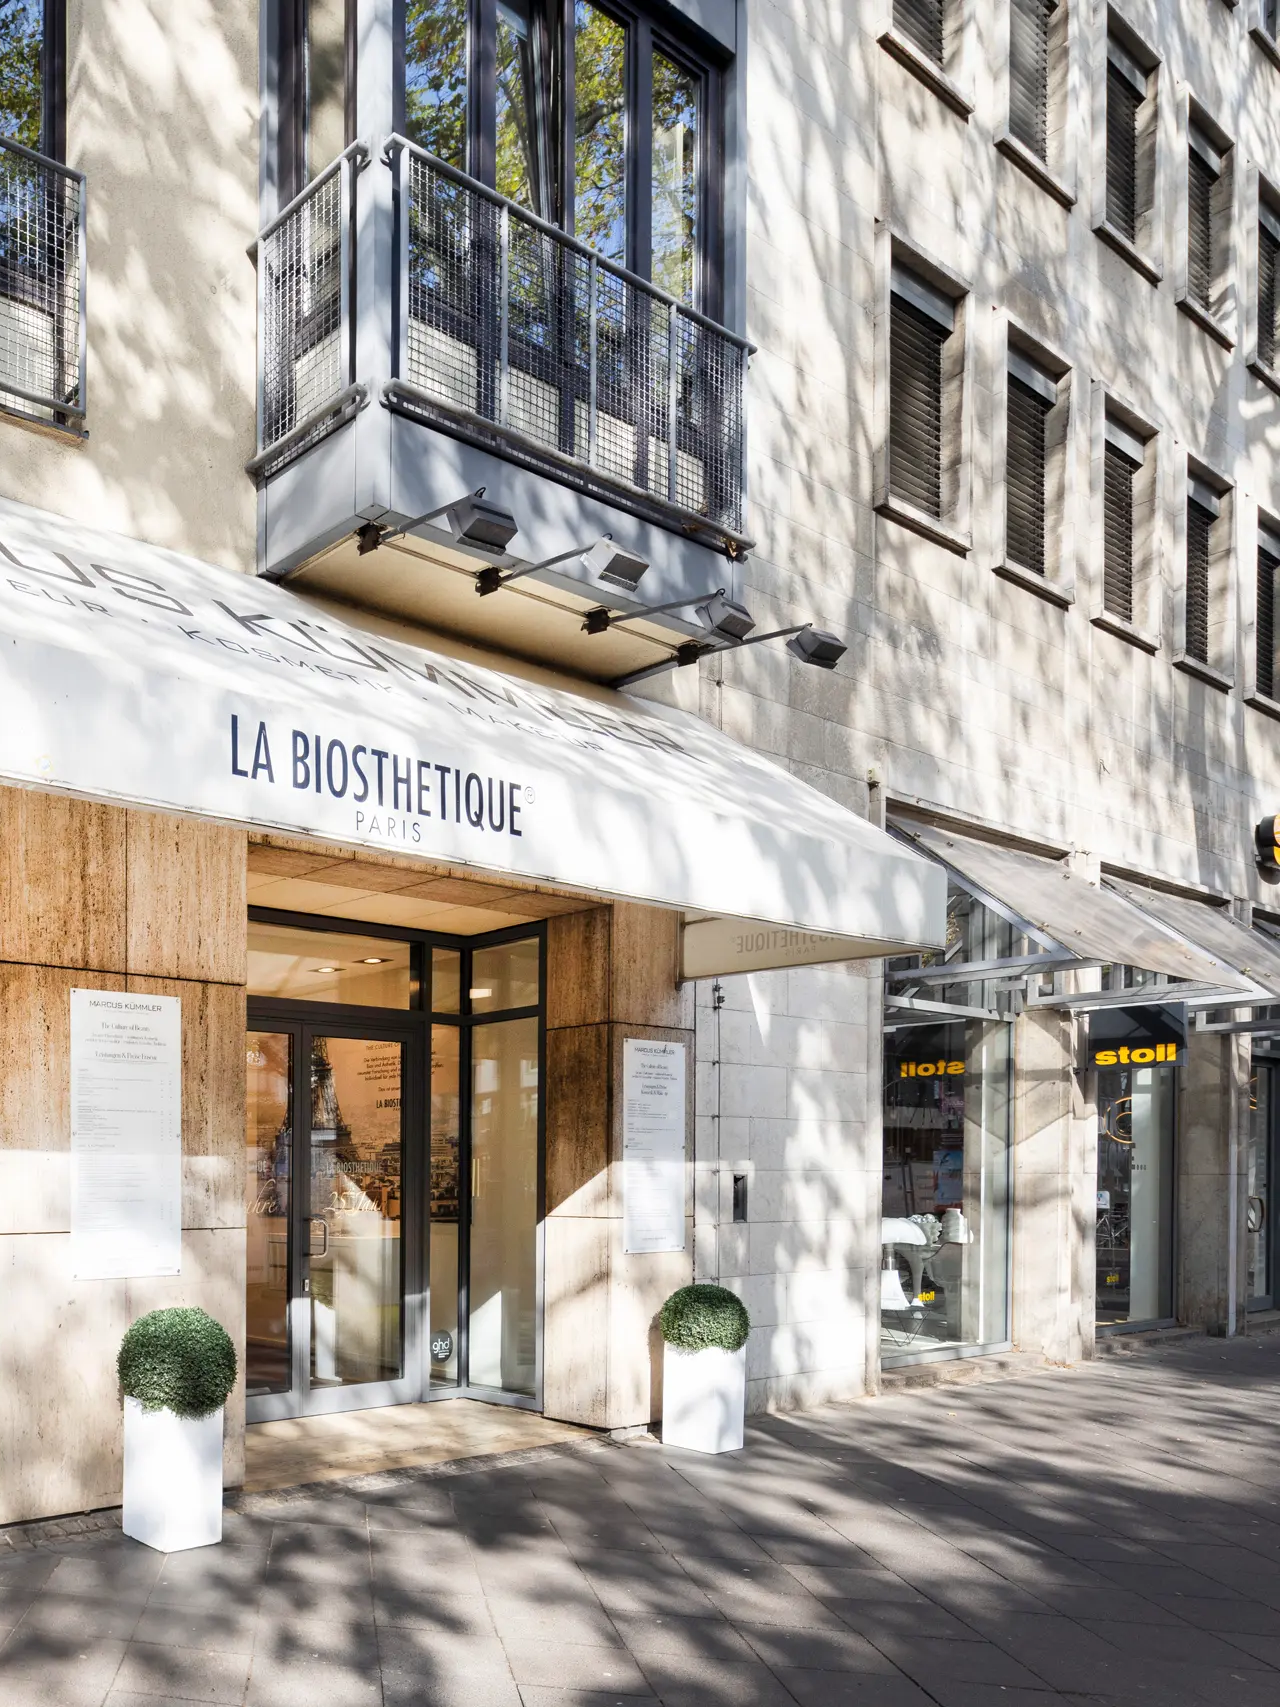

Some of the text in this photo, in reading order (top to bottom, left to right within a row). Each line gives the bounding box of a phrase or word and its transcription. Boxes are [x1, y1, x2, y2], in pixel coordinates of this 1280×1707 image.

[177, 625, 402, 695] KOSMETIK
[231, 714, 275, 783] LA
[356, 810, 422, 843] PARIS
[89, 1000, 123, 1009] MARCUS
[124, 1002, 162, 1012] KÜMMLER
[1095, 1043, 1177, 1066] stoll
[376, 1099, 383, 1109] LA
[432, 1337, 450, 1353] ghd
